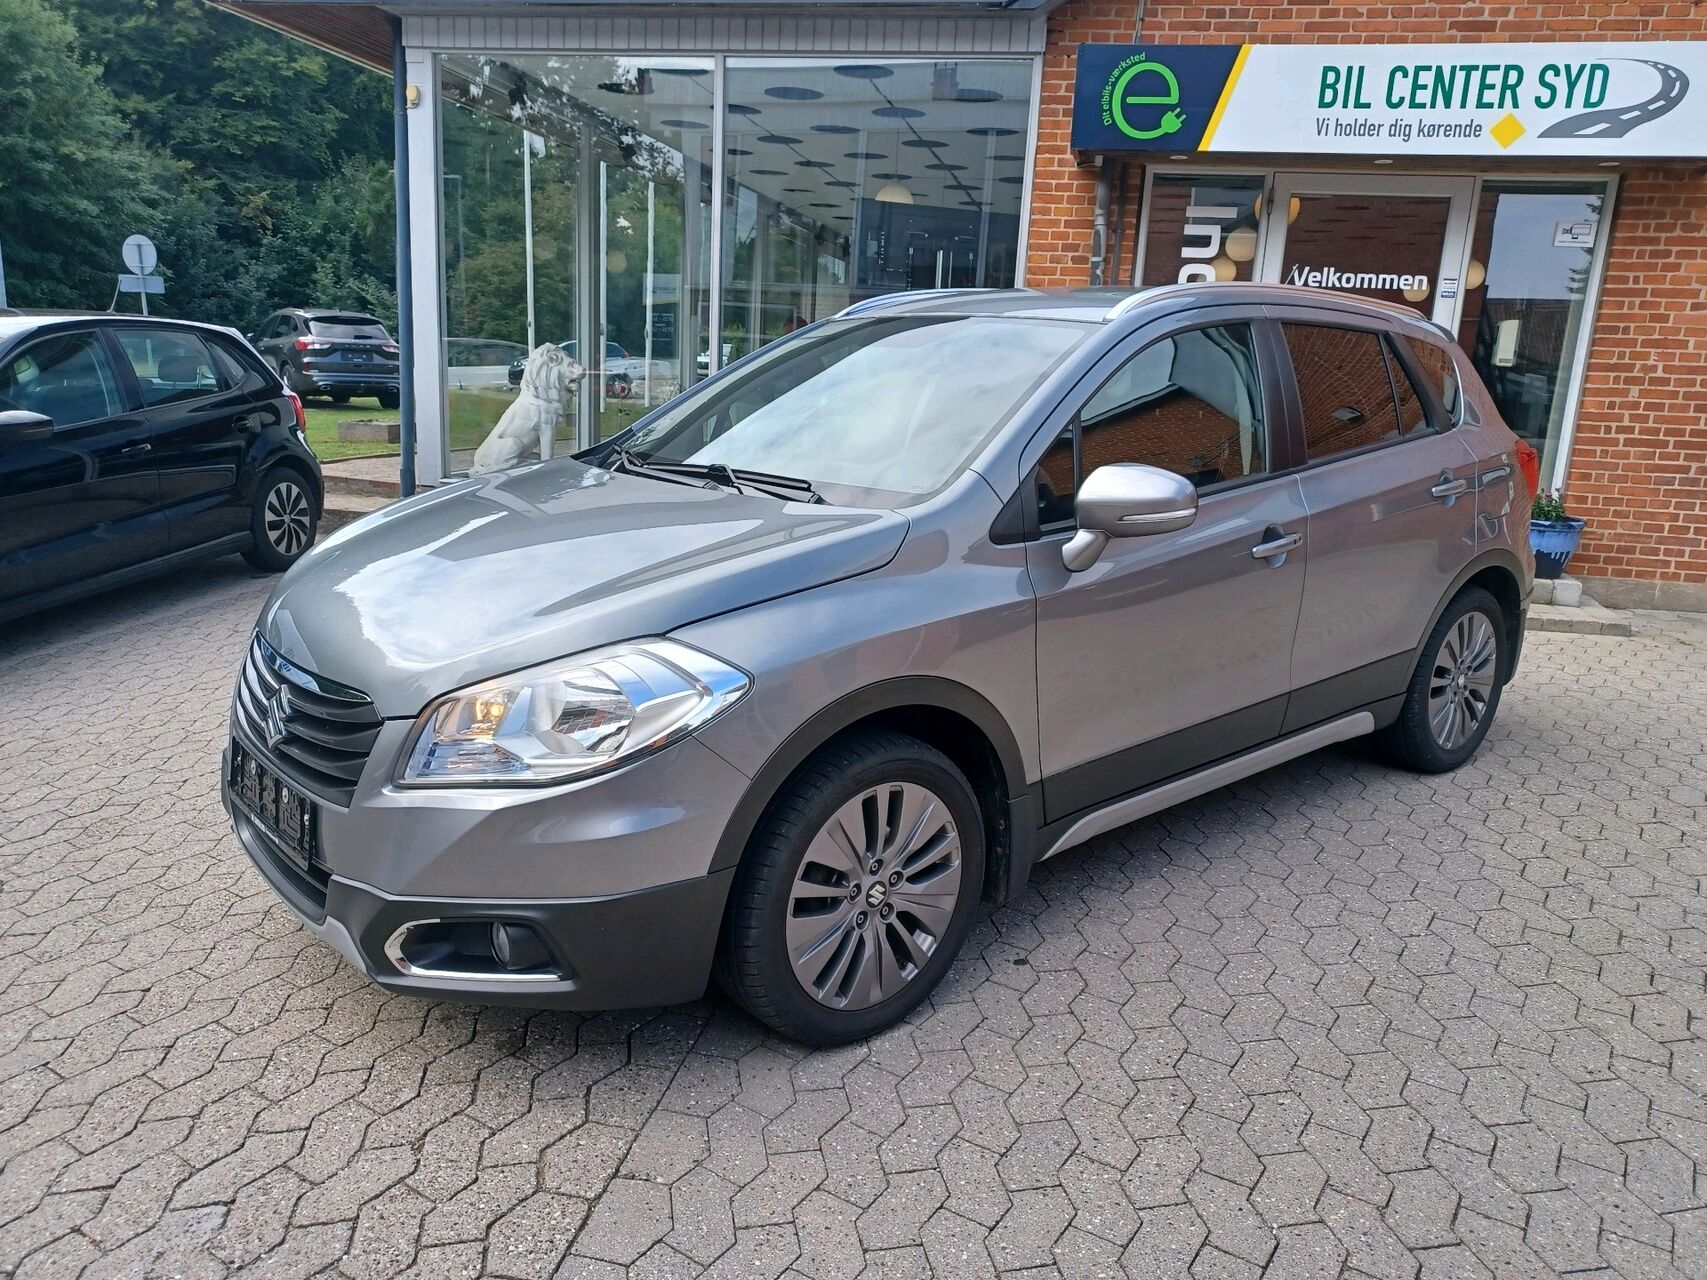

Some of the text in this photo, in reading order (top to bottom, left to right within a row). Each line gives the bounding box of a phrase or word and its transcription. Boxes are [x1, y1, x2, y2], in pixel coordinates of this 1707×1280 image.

[1317, 63, 1610, 109] BIL CENTER SYD
[1101, 111, 1113, 126] Dit
[1315, 118, 1483, 143] Vi holder dig kørende
[1293, 265, 1429, 291] Velkommen
